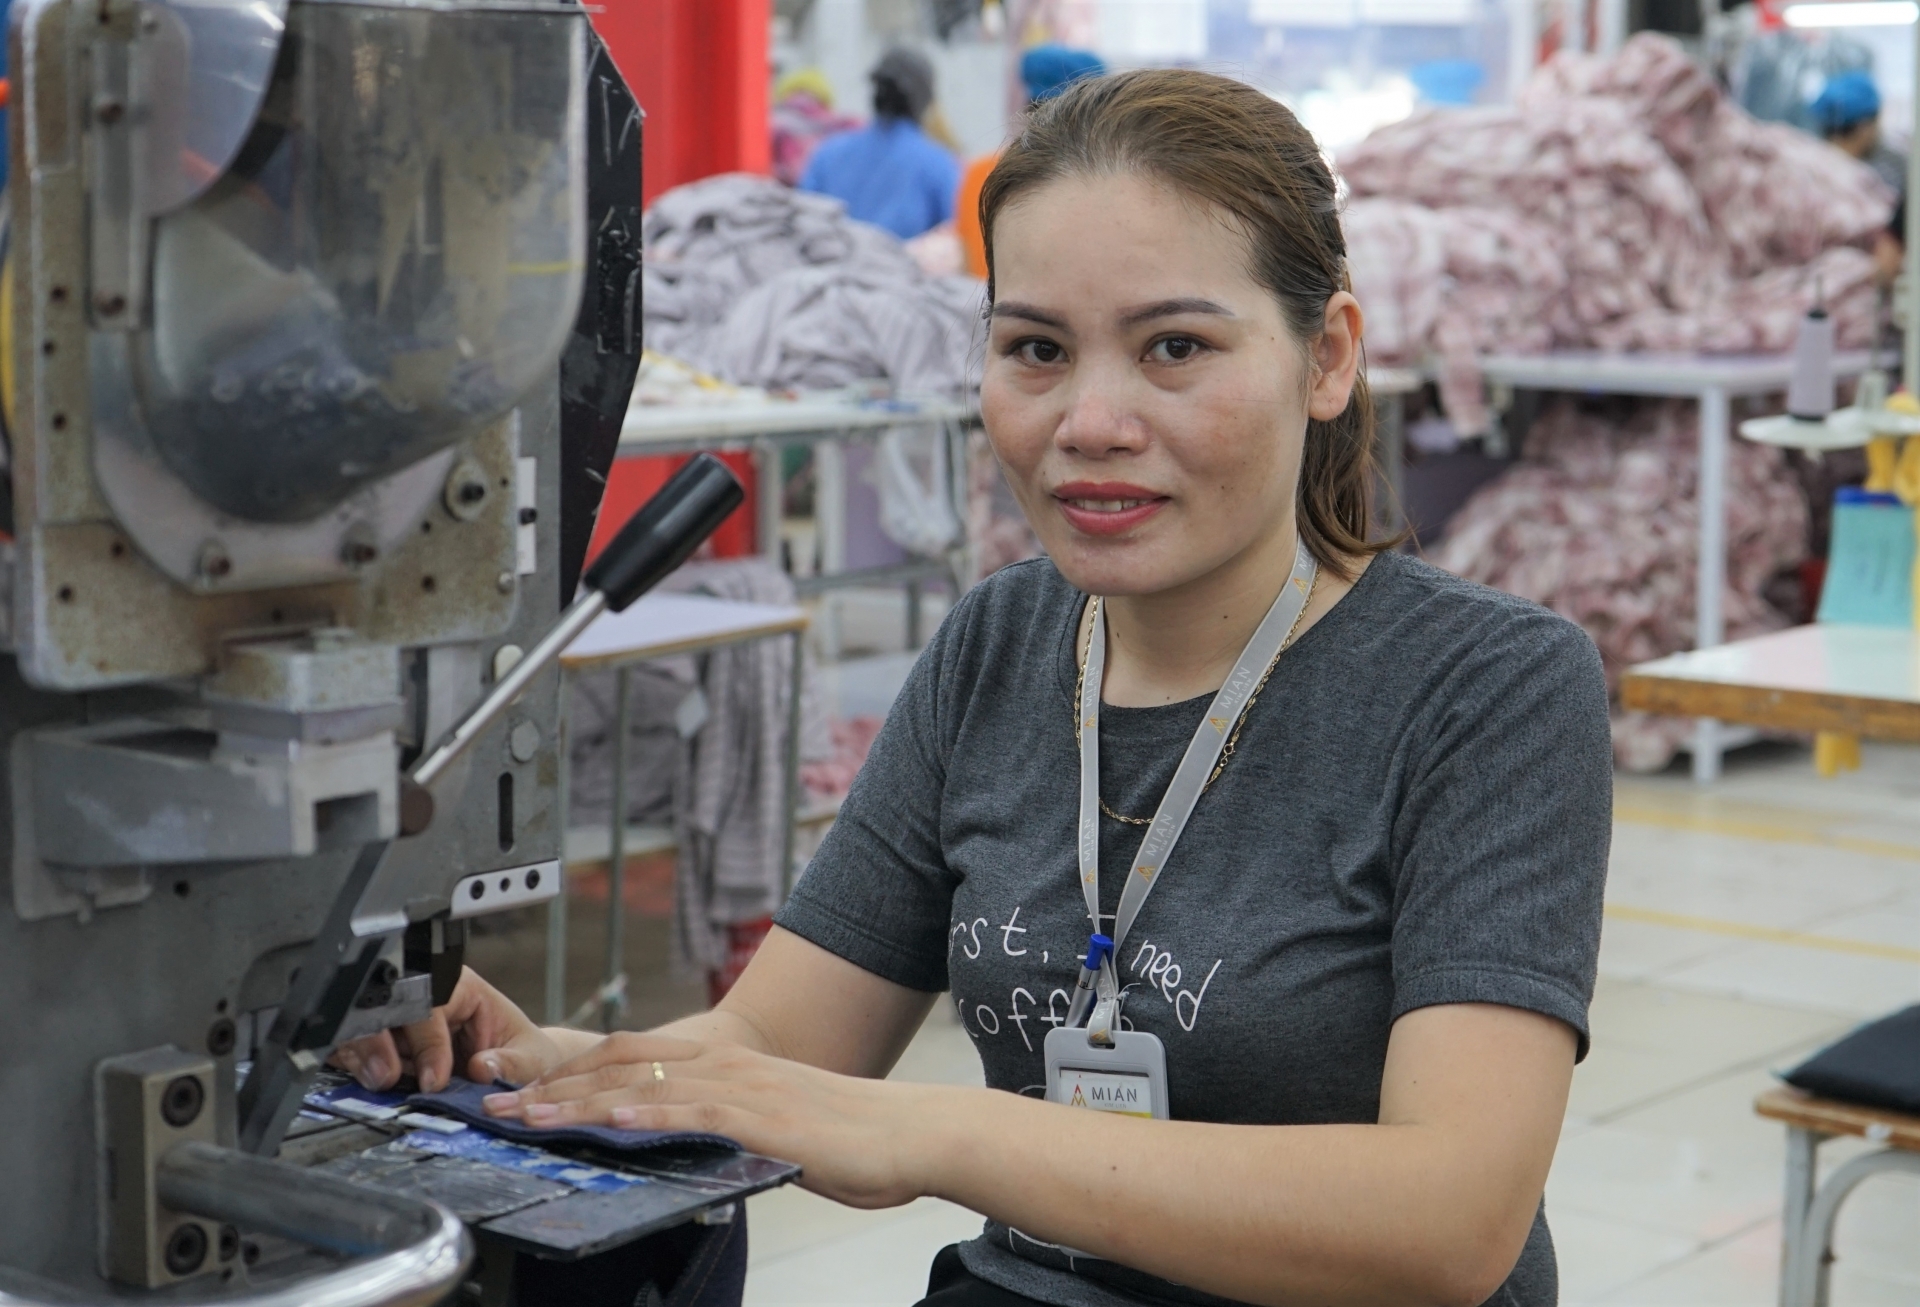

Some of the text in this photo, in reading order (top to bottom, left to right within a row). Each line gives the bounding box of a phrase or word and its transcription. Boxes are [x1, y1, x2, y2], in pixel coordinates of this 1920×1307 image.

[1085, 666, 1097, 708] MIAN
[1220, 666, 1251, 709] MIAN
[1083, 818, 1092, 862] MIAN
[1145, 813, 1174, 857] MIAN
[950, 906, 1049, 964] rst,
[1130, 939, 1223, 1031] need
[1091, 1086, 1138, 1102] MIAN
